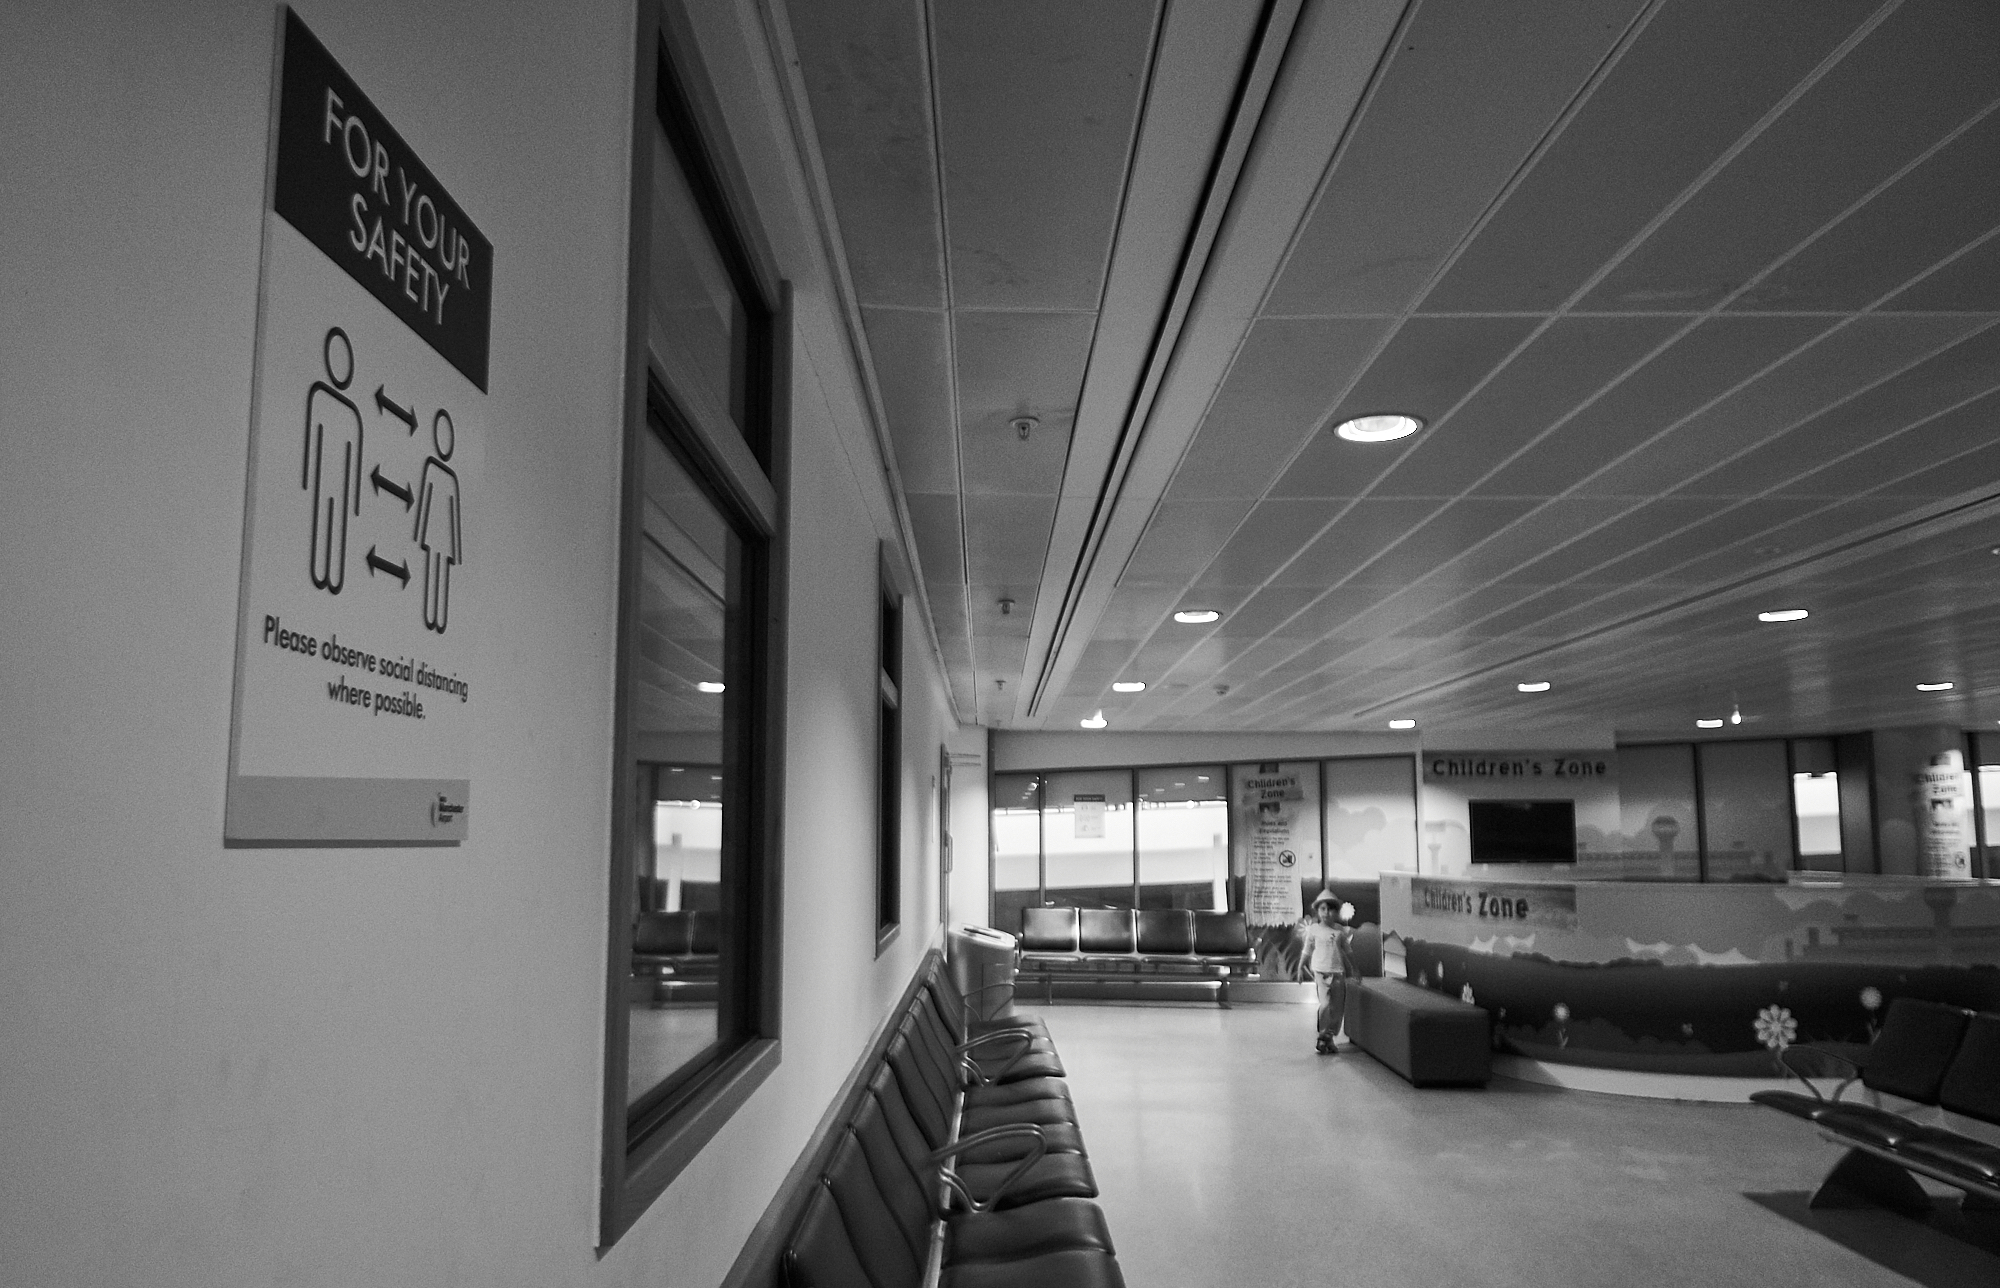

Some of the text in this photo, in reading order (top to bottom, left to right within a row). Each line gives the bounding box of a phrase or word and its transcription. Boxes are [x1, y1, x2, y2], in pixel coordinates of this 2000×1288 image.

[324, 86, 470, 290] FOR YOUR
[350, 193, 450, 325] SAFETY
[264, 614, 469, 703] Please observe social distancing
[328, 675, 426, 720] where possible.
[1247, 776, 1296, 789] Children's
[1432, 758, 1606, 777] Children's Zone
[1260, 788, 1285, 799] Zone
[1424, 886, 1530, 919] Children's Zone
